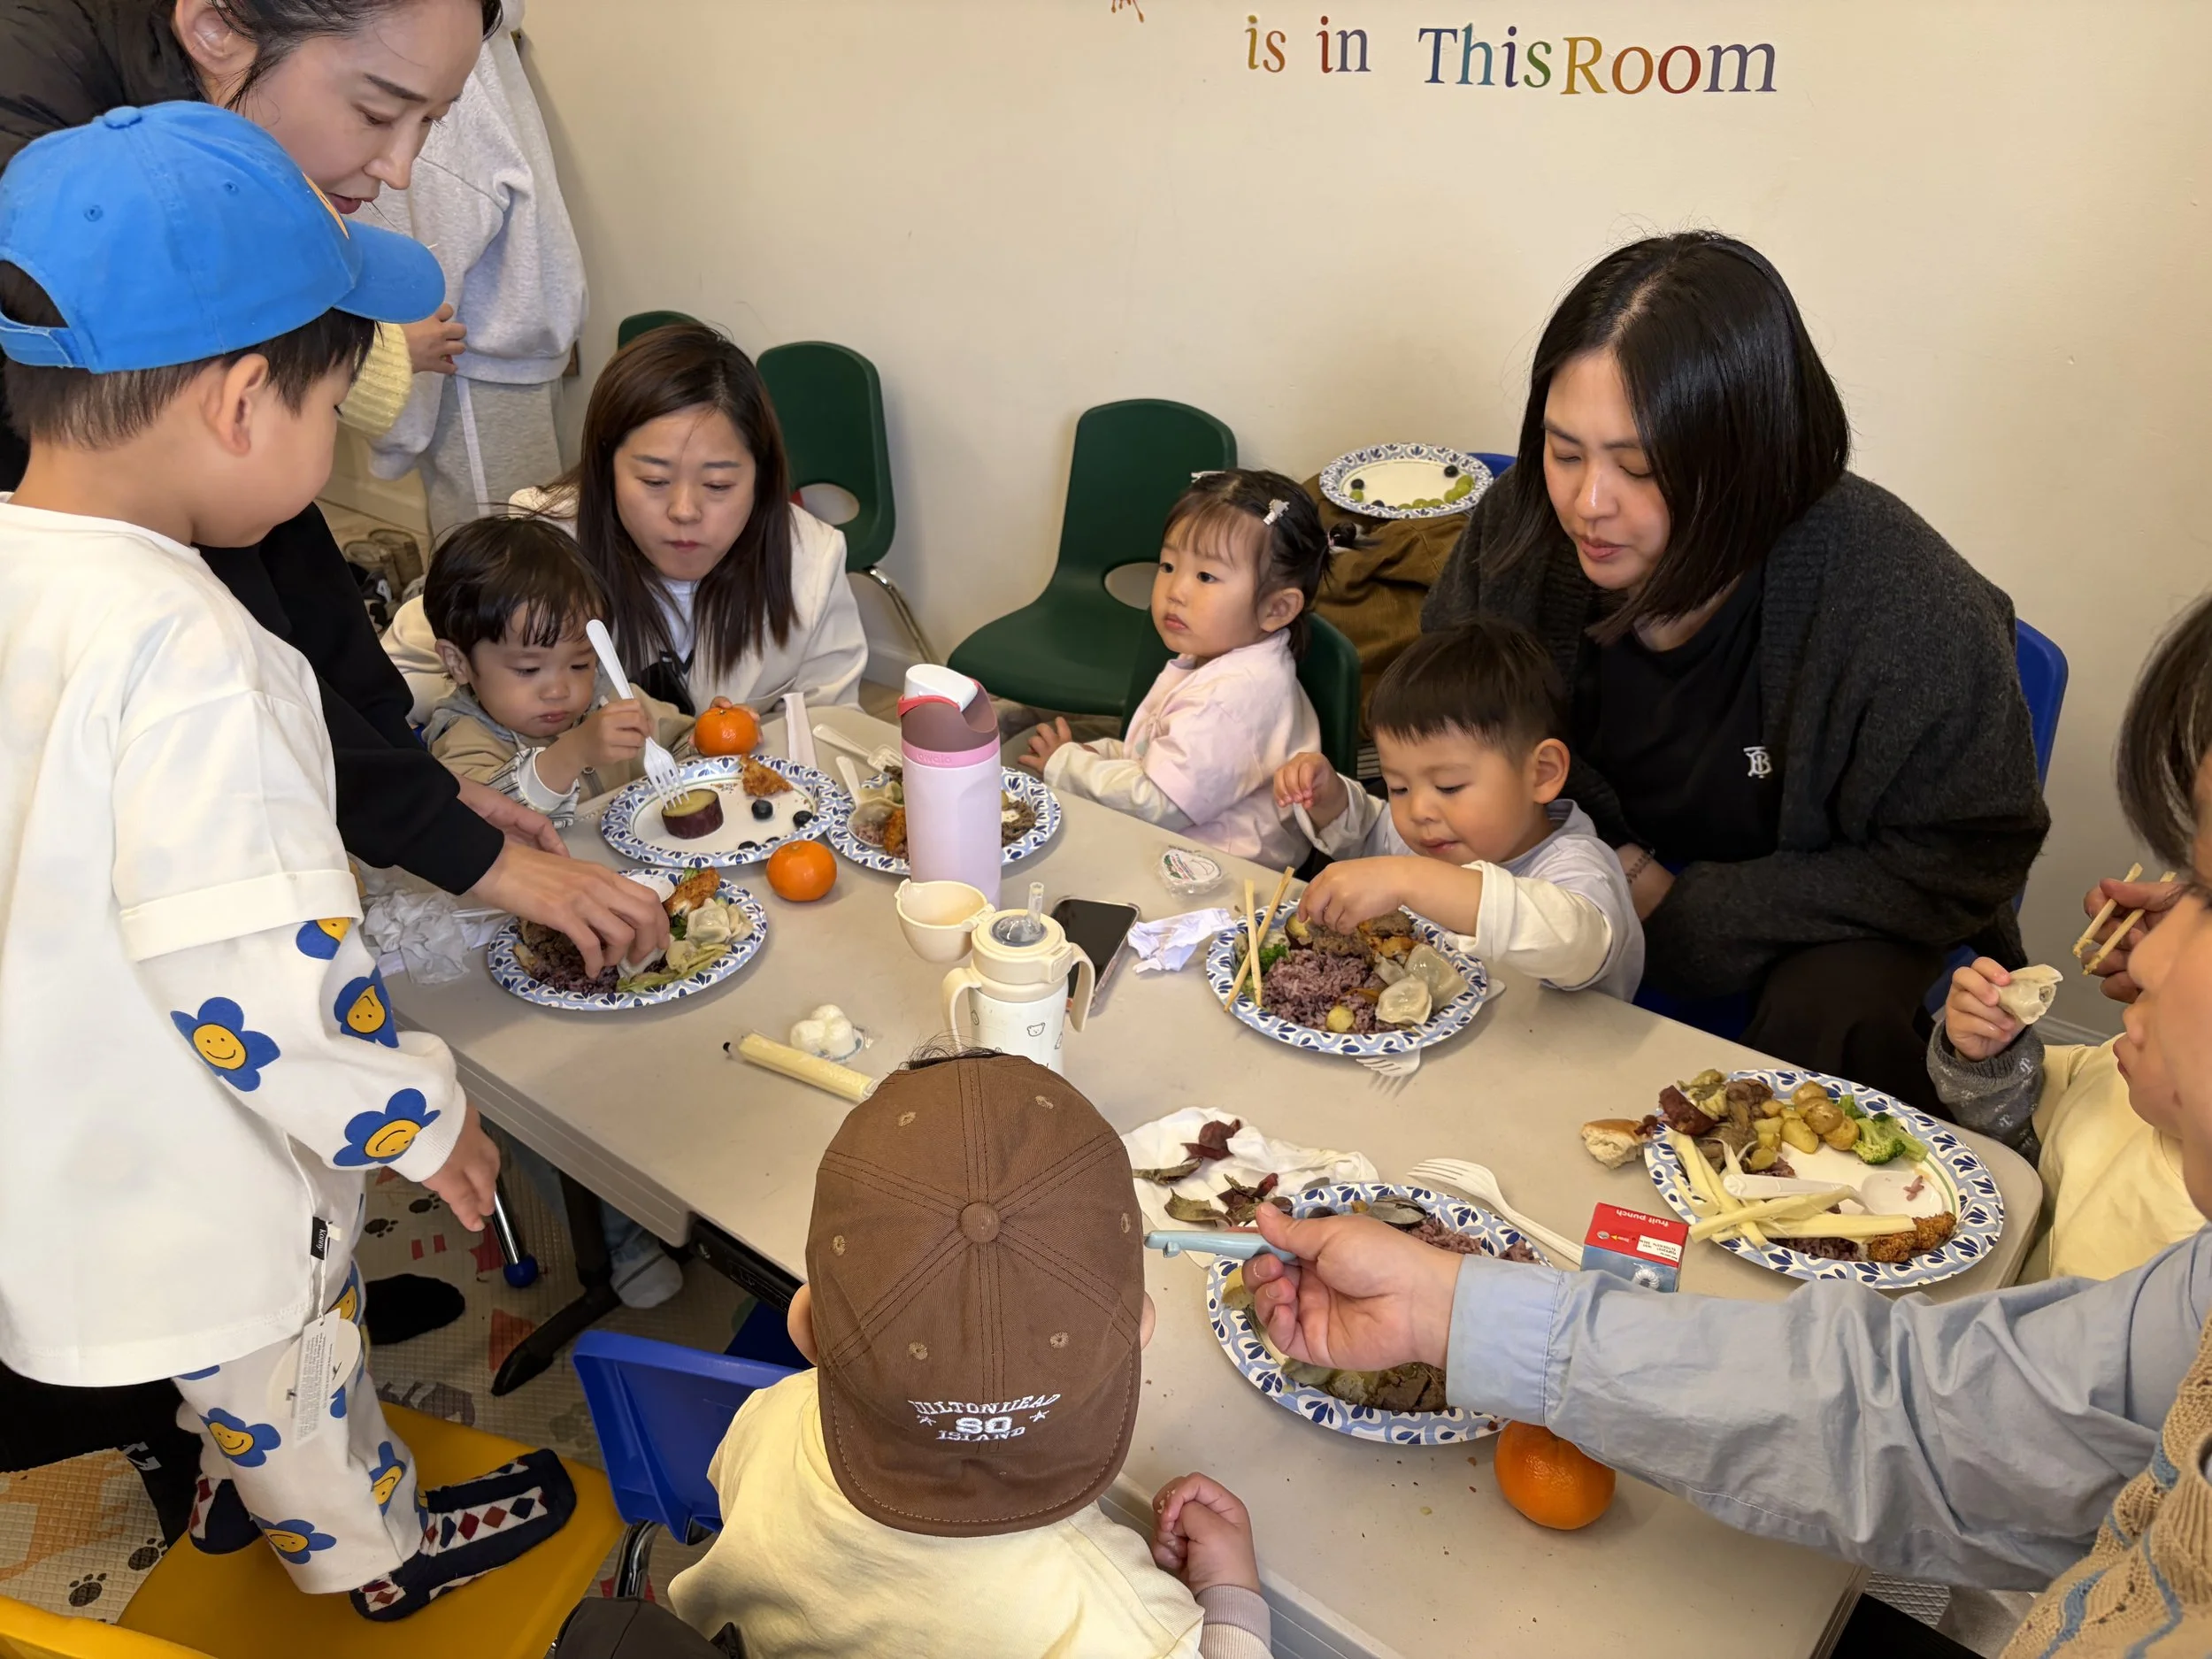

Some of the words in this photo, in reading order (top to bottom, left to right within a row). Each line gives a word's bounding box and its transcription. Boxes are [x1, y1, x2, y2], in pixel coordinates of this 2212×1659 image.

[1245, 15, 1286, 73] is
[1317, 15, 1371, 74] in
[1617, 1210, 1647, 1221] punch
[1647, 1217, 1670, 1227] fruit
[935, 1425, 1025, 1441] ISLAND
